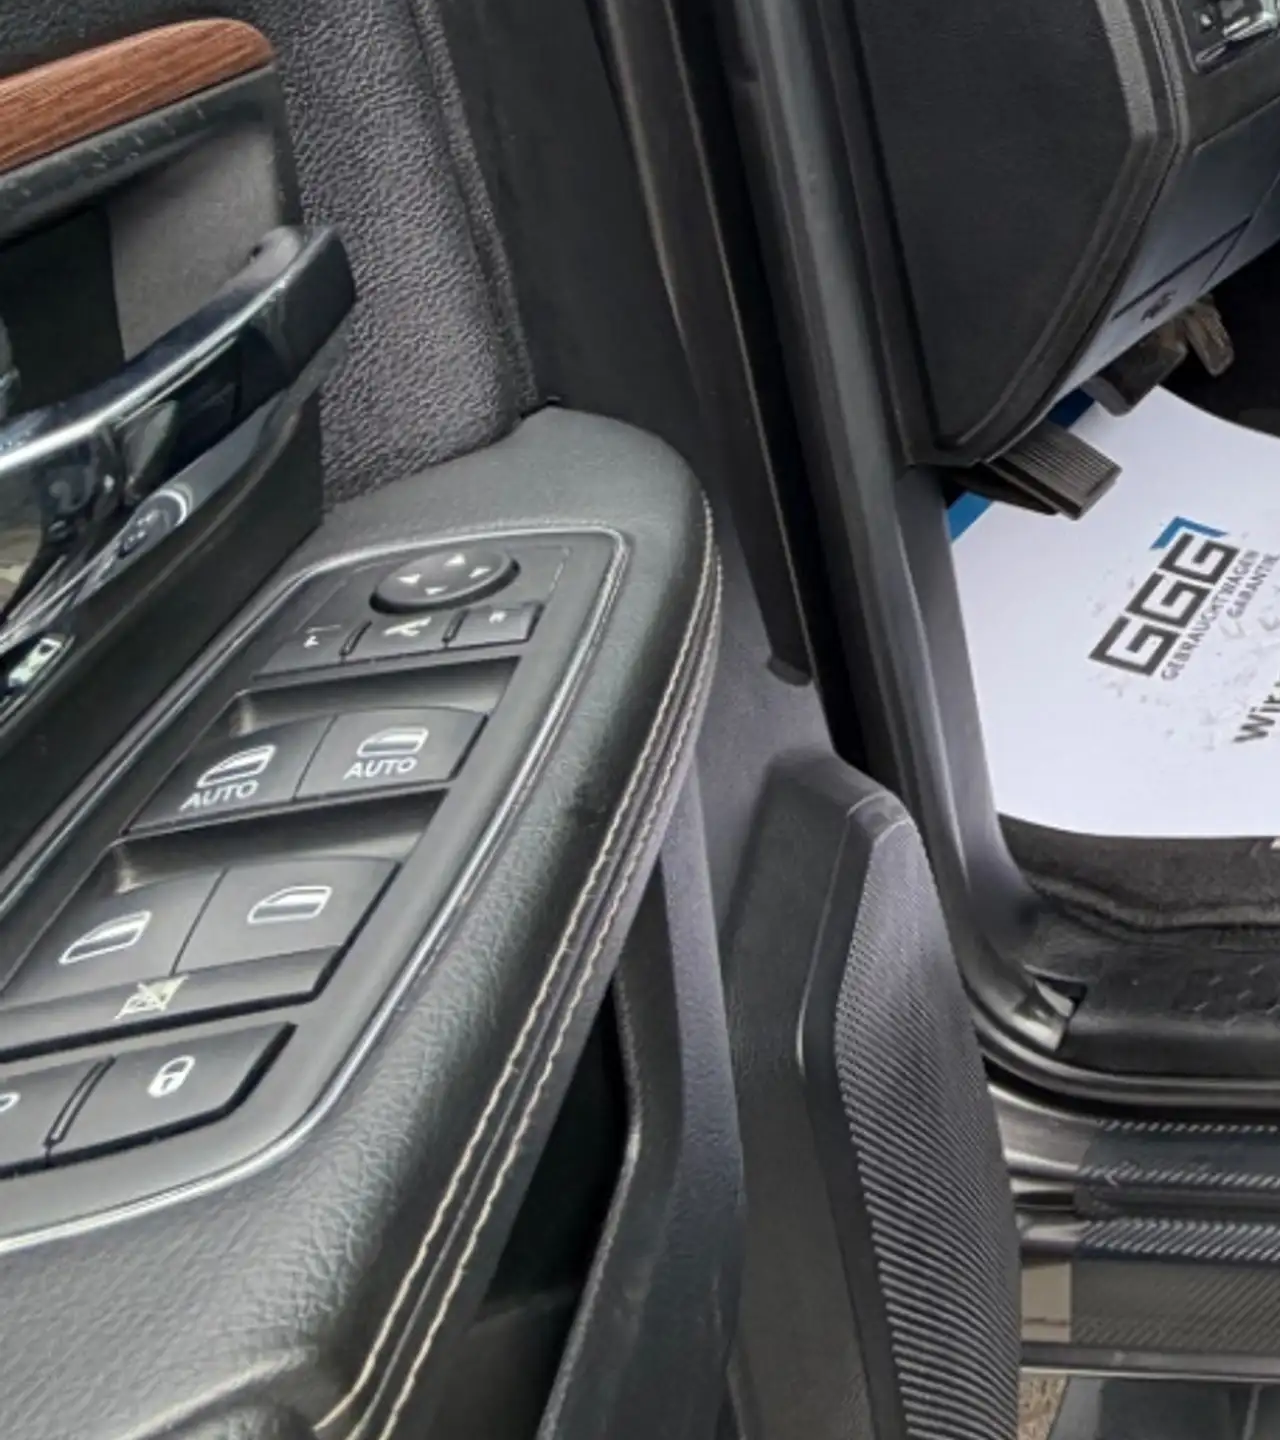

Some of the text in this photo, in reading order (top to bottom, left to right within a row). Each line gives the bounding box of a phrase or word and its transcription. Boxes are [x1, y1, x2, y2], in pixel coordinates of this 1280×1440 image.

[1088, 532, 1240, 677] GGG
[343, 757, 418, 780] AUTO
[179, 779, 260, 812] AUTO
